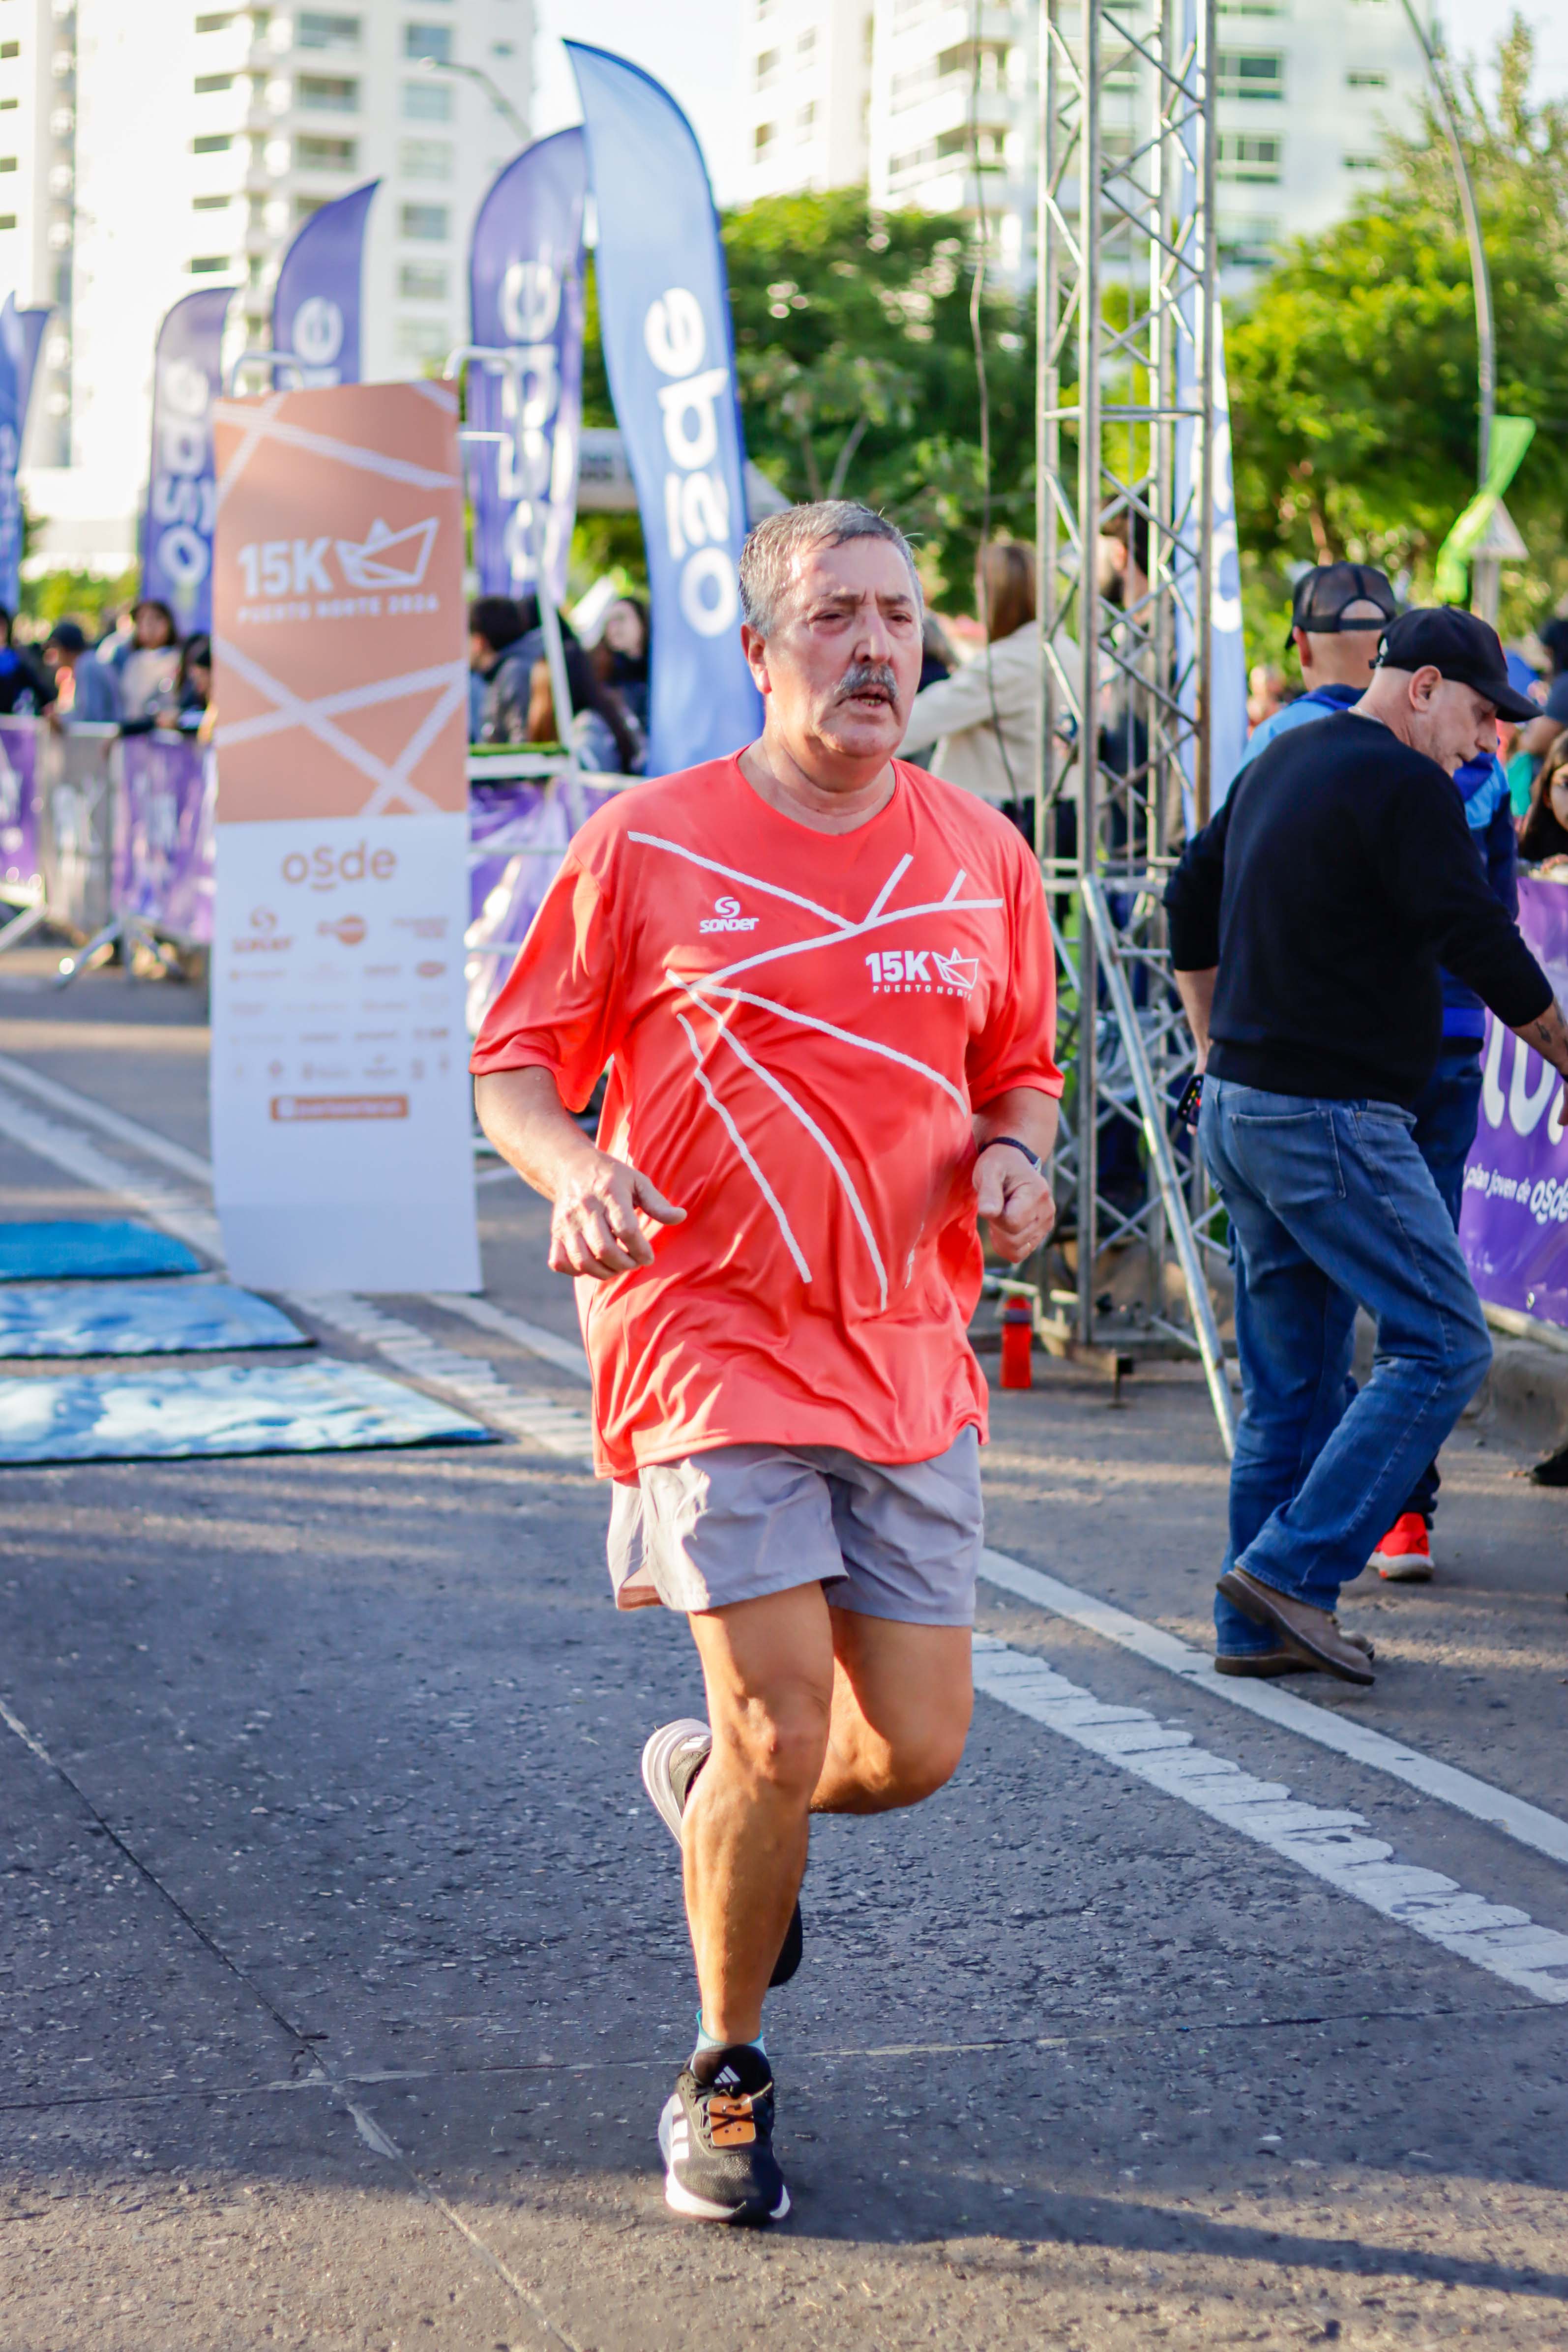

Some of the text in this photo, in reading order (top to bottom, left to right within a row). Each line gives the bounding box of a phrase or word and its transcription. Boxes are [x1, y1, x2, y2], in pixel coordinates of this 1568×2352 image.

[237, 536, 333, 598] 15K
[316, 595, 382, 619] NORTE
[282, 838, 396, 891] osde
[865, 950, 931, 982] 15K
[873, 984, 931, 994] PUERTO
